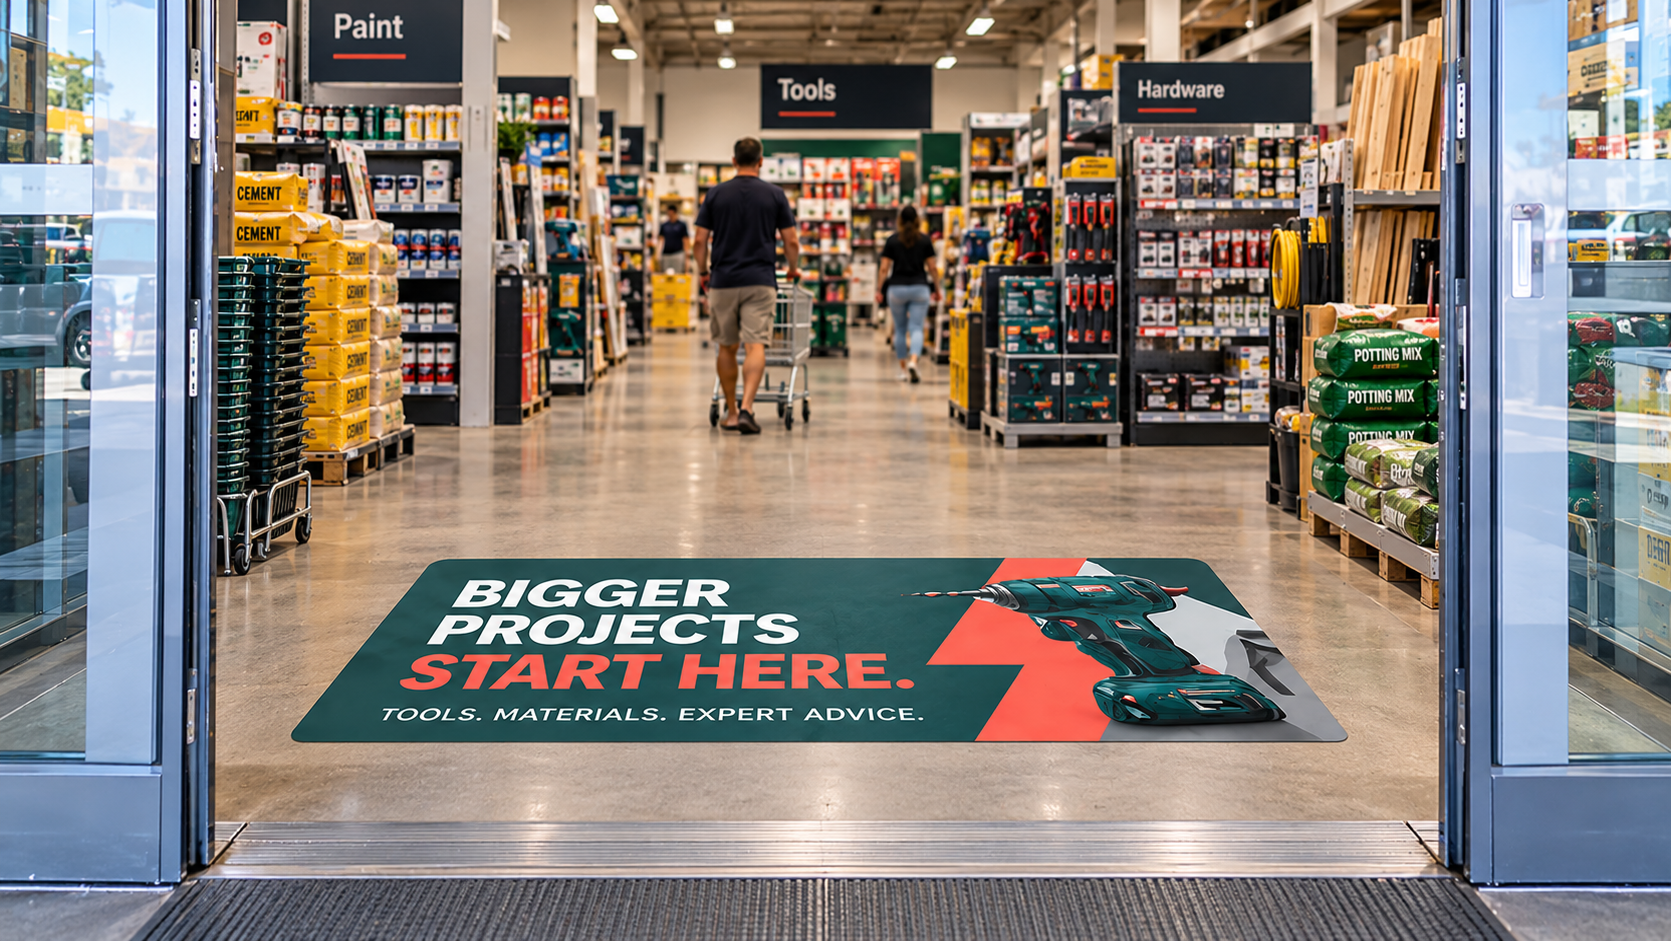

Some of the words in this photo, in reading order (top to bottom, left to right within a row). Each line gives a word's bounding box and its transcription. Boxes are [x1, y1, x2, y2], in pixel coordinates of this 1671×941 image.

[334, 13, 404, 39] Paint
[778, 78, 836, 101] Tools
[1137, 79, 1225, 99] Hardware
[237, 186, 282, 201] CEMENT
[236, 226, 281, 241] CEMENT
[1354, 347, 1399, 362] POTTING
[1401, 346, 1422, 361] MIX
[1347, 390, 1392, 404] POTTING
[1394, 388, 1415, 403] MIX
[452, 579, 730, 607] BIGGER
[427, 613, 799, 645] PROJECTS
[400, 653, 662, 690] START
[678, 653, 915, 690] HERE.
[382, 707, 482, 722] TOOLS.
[493, 707, 666, 722] MATERIALS.
[678, 707, 793, 721] EXPERT
[803, 707, 924, 721] ADVICE.
